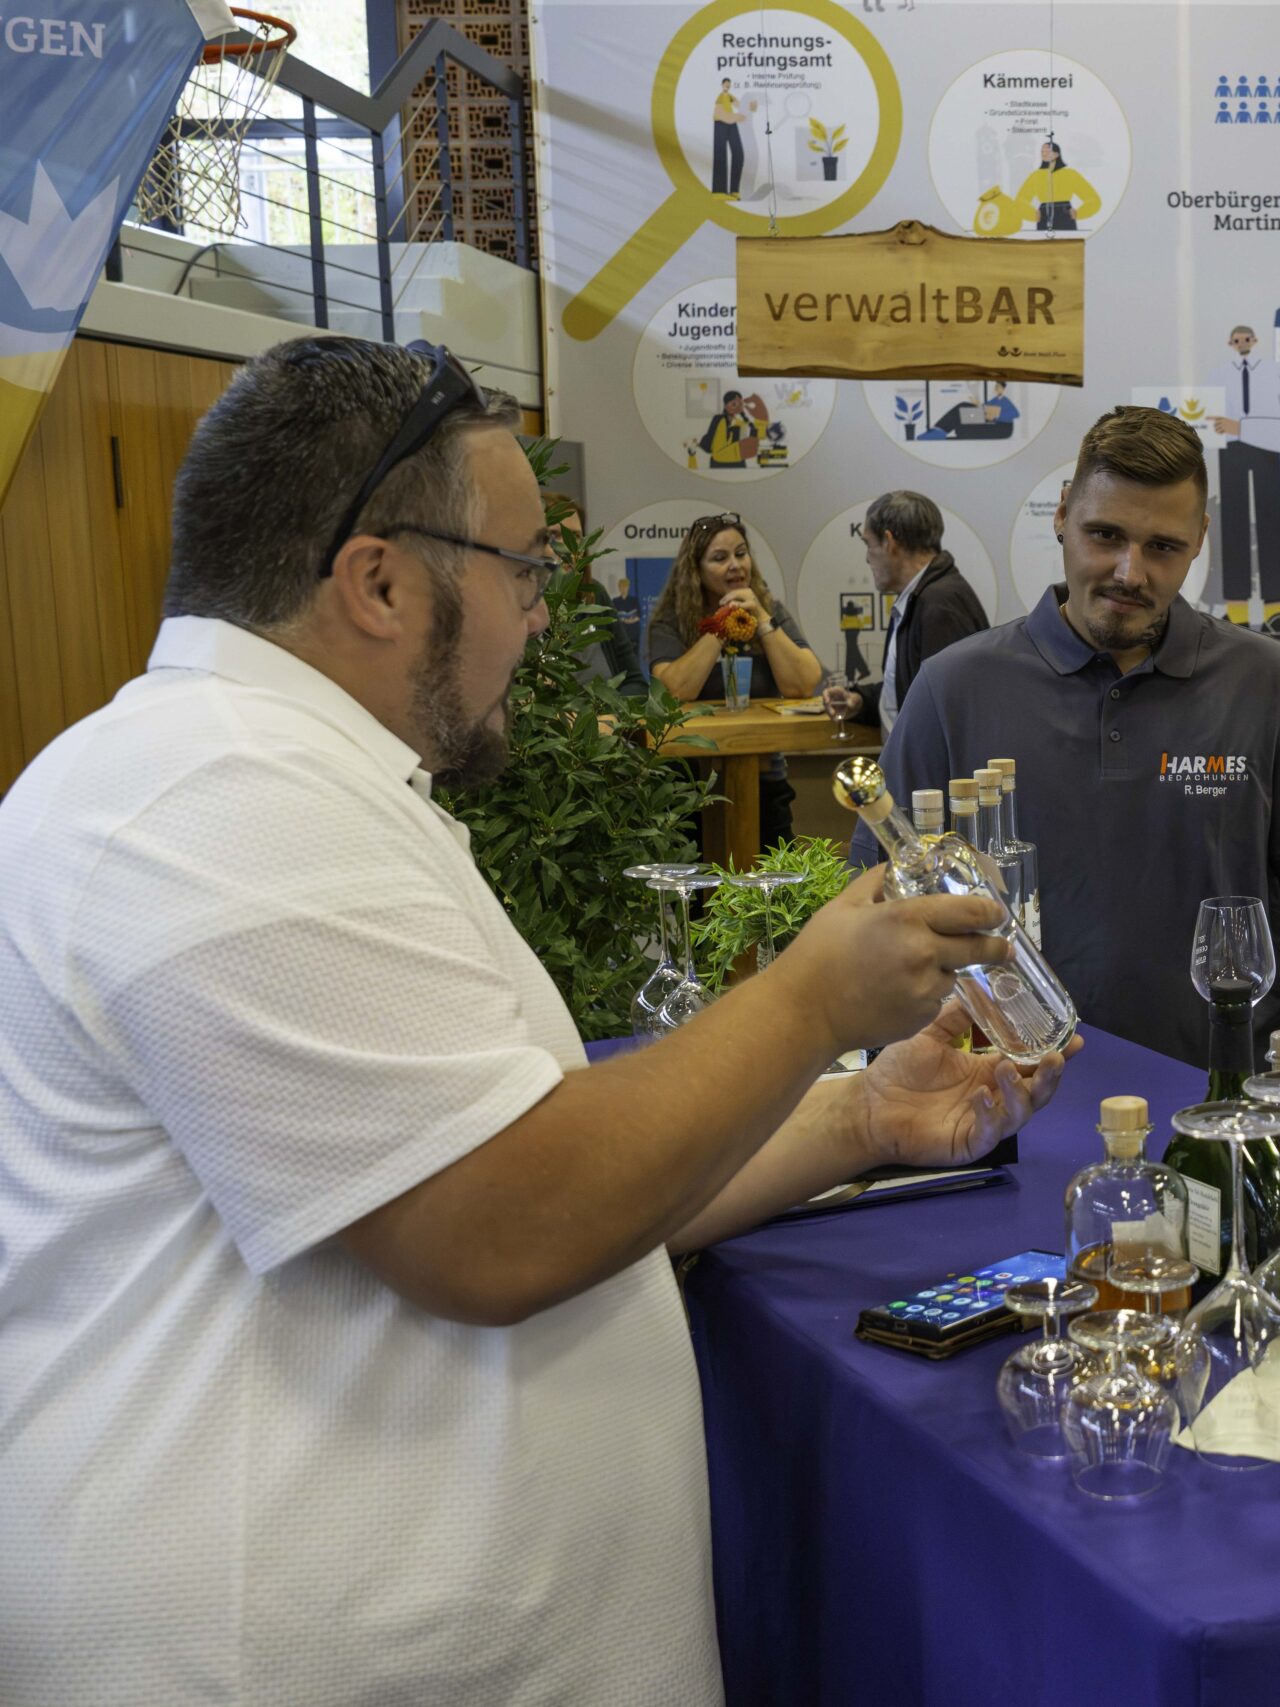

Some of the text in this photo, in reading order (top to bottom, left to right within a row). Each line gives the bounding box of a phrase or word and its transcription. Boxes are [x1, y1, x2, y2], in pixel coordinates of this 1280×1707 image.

[0, 15, 106, 58] GEN
[722, 33, 832, 52] Rechnungs-
[717, 52, 832, 71] prüfungsamt
[983, 73, 1073, 88] Kämmerei
[678, 302, 737, 318] Kinder
[764, 282, 1056, 325] verwaltBAR
[668, 322, 737, 341] Jugend
[1160, 752, 1247, 774] HARMES
[1159, 774, 1249, 782] BEDACHUNGEN
[1184, 785, 1228, 797] R. Berger
